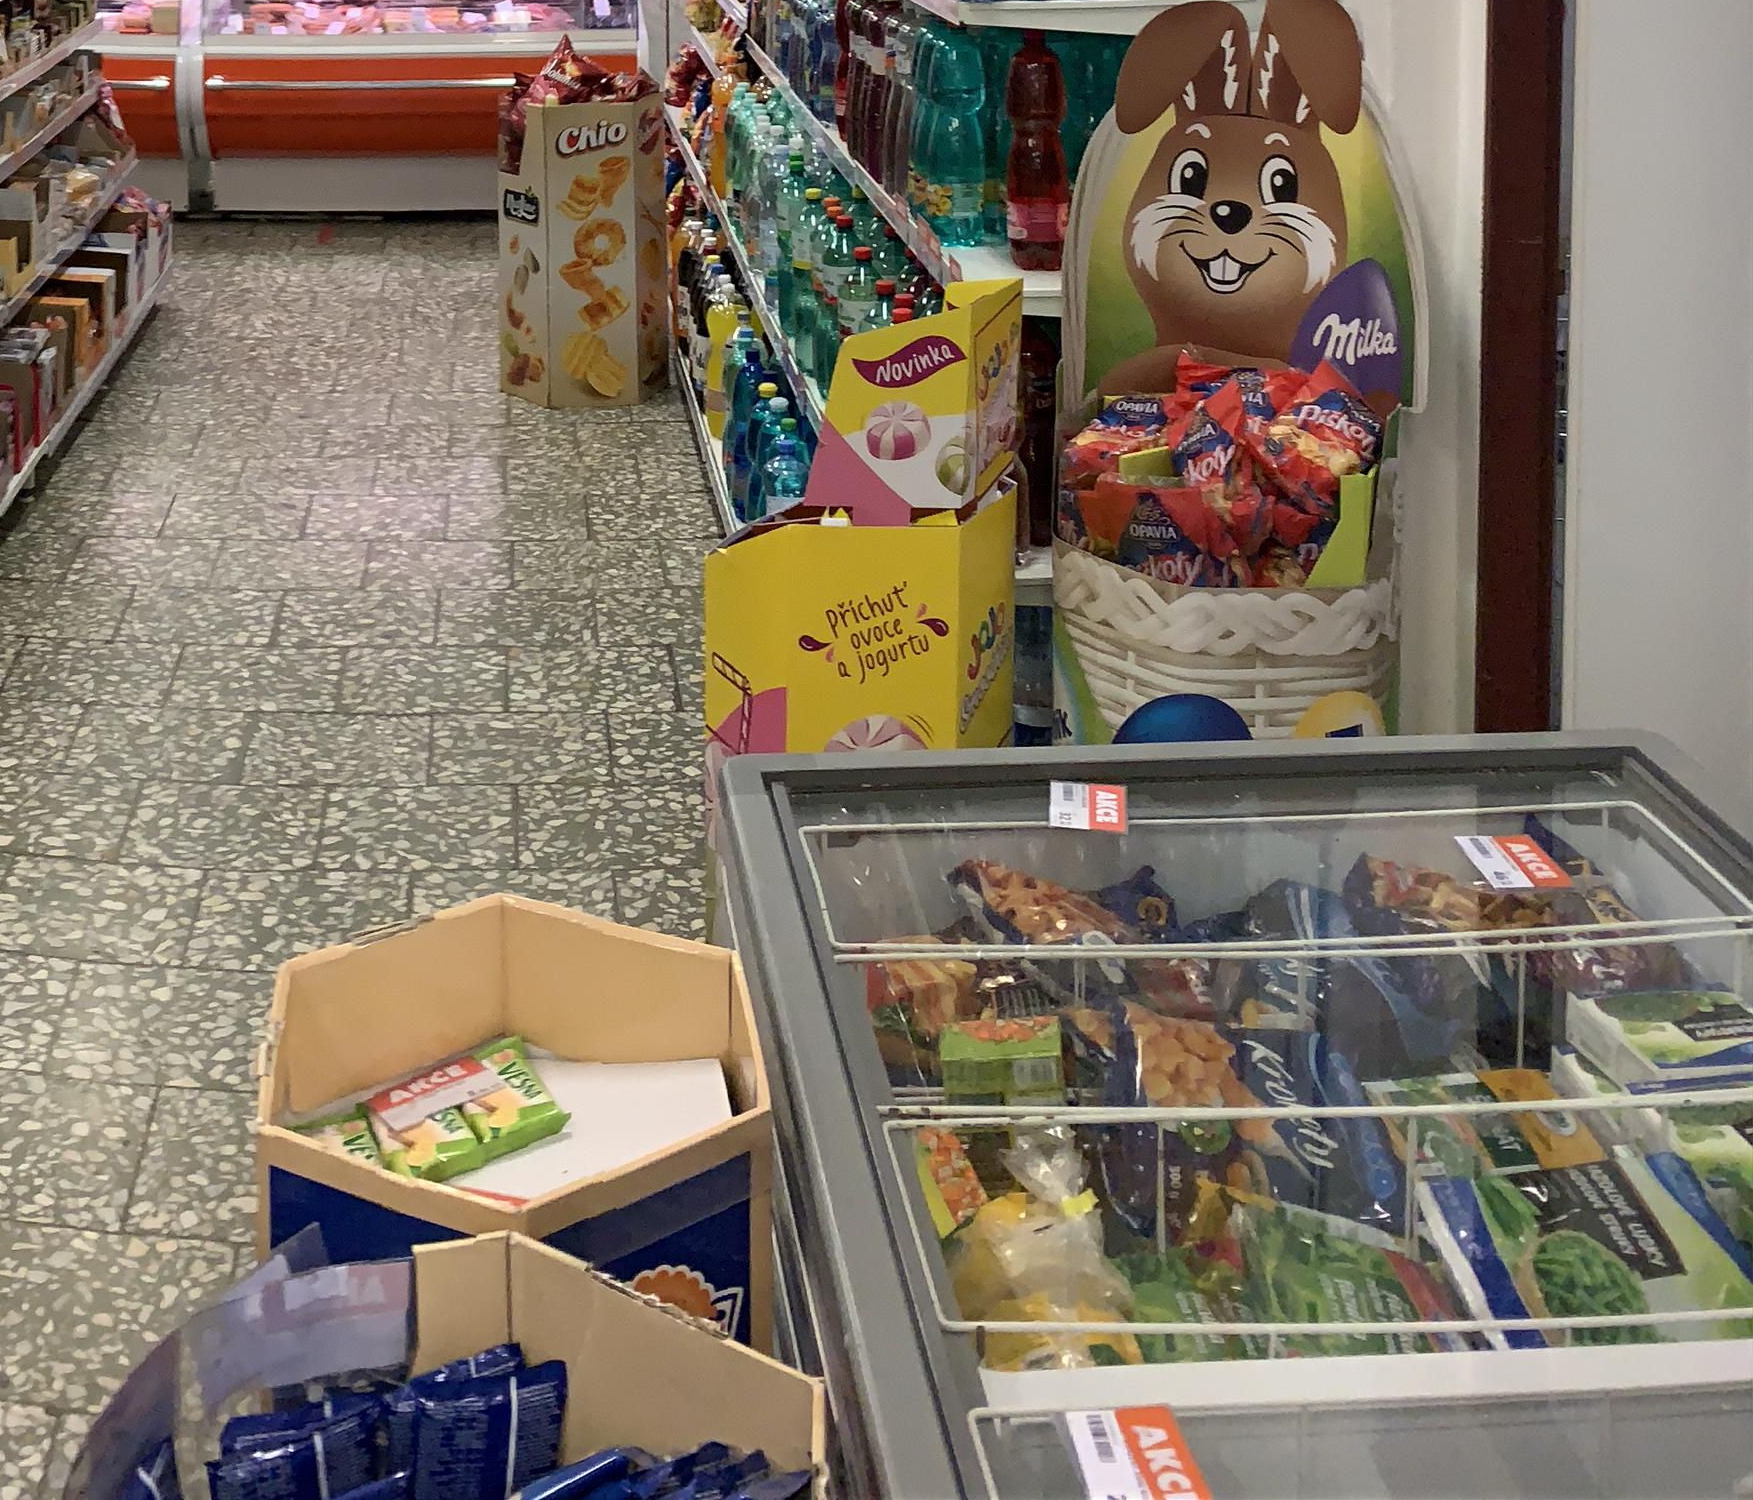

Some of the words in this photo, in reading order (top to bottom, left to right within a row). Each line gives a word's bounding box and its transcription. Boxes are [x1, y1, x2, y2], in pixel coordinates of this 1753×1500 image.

[557, 117, 628, 157] Chio
[1312, 313, 1397, 366] Milka
[875, 344, 956, 385] Novinka
[1116, 400, 1159, 415] OPAVIA
[1128, 523, 1178, 541] OPAVIA
[825, 580, 908, 640] Příchuť
[849, 618, 904, 651] ovoce
[837, 660, 852, 679] a
[858, 634, 931, 685] jogurtu
[1096, 788, 1120, 824] AKCE
[1504, 841, 1559, 880] AKCE
[387, 1061, 469, 1106] AKCE
